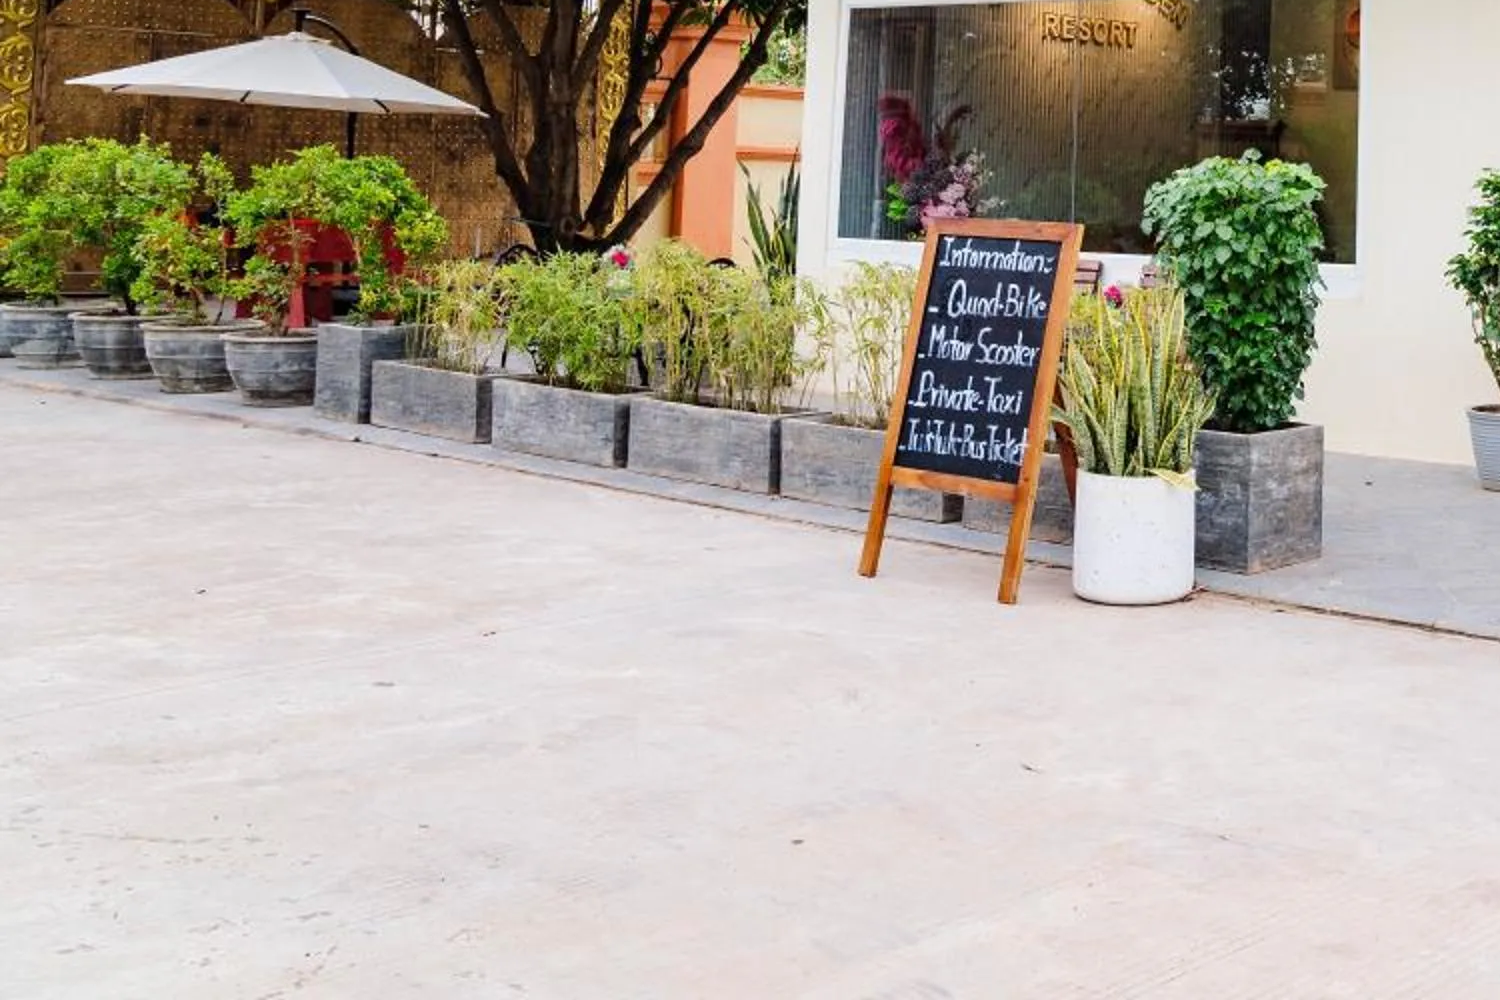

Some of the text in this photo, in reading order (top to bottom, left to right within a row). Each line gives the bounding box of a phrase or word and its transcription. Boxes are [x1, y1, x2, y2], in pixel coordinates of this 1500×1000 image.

[1043, 12, 1138, 48] RESORT
[927, 324, 975, 361] Motor
[975, 326, 1040, 367] Scooter
